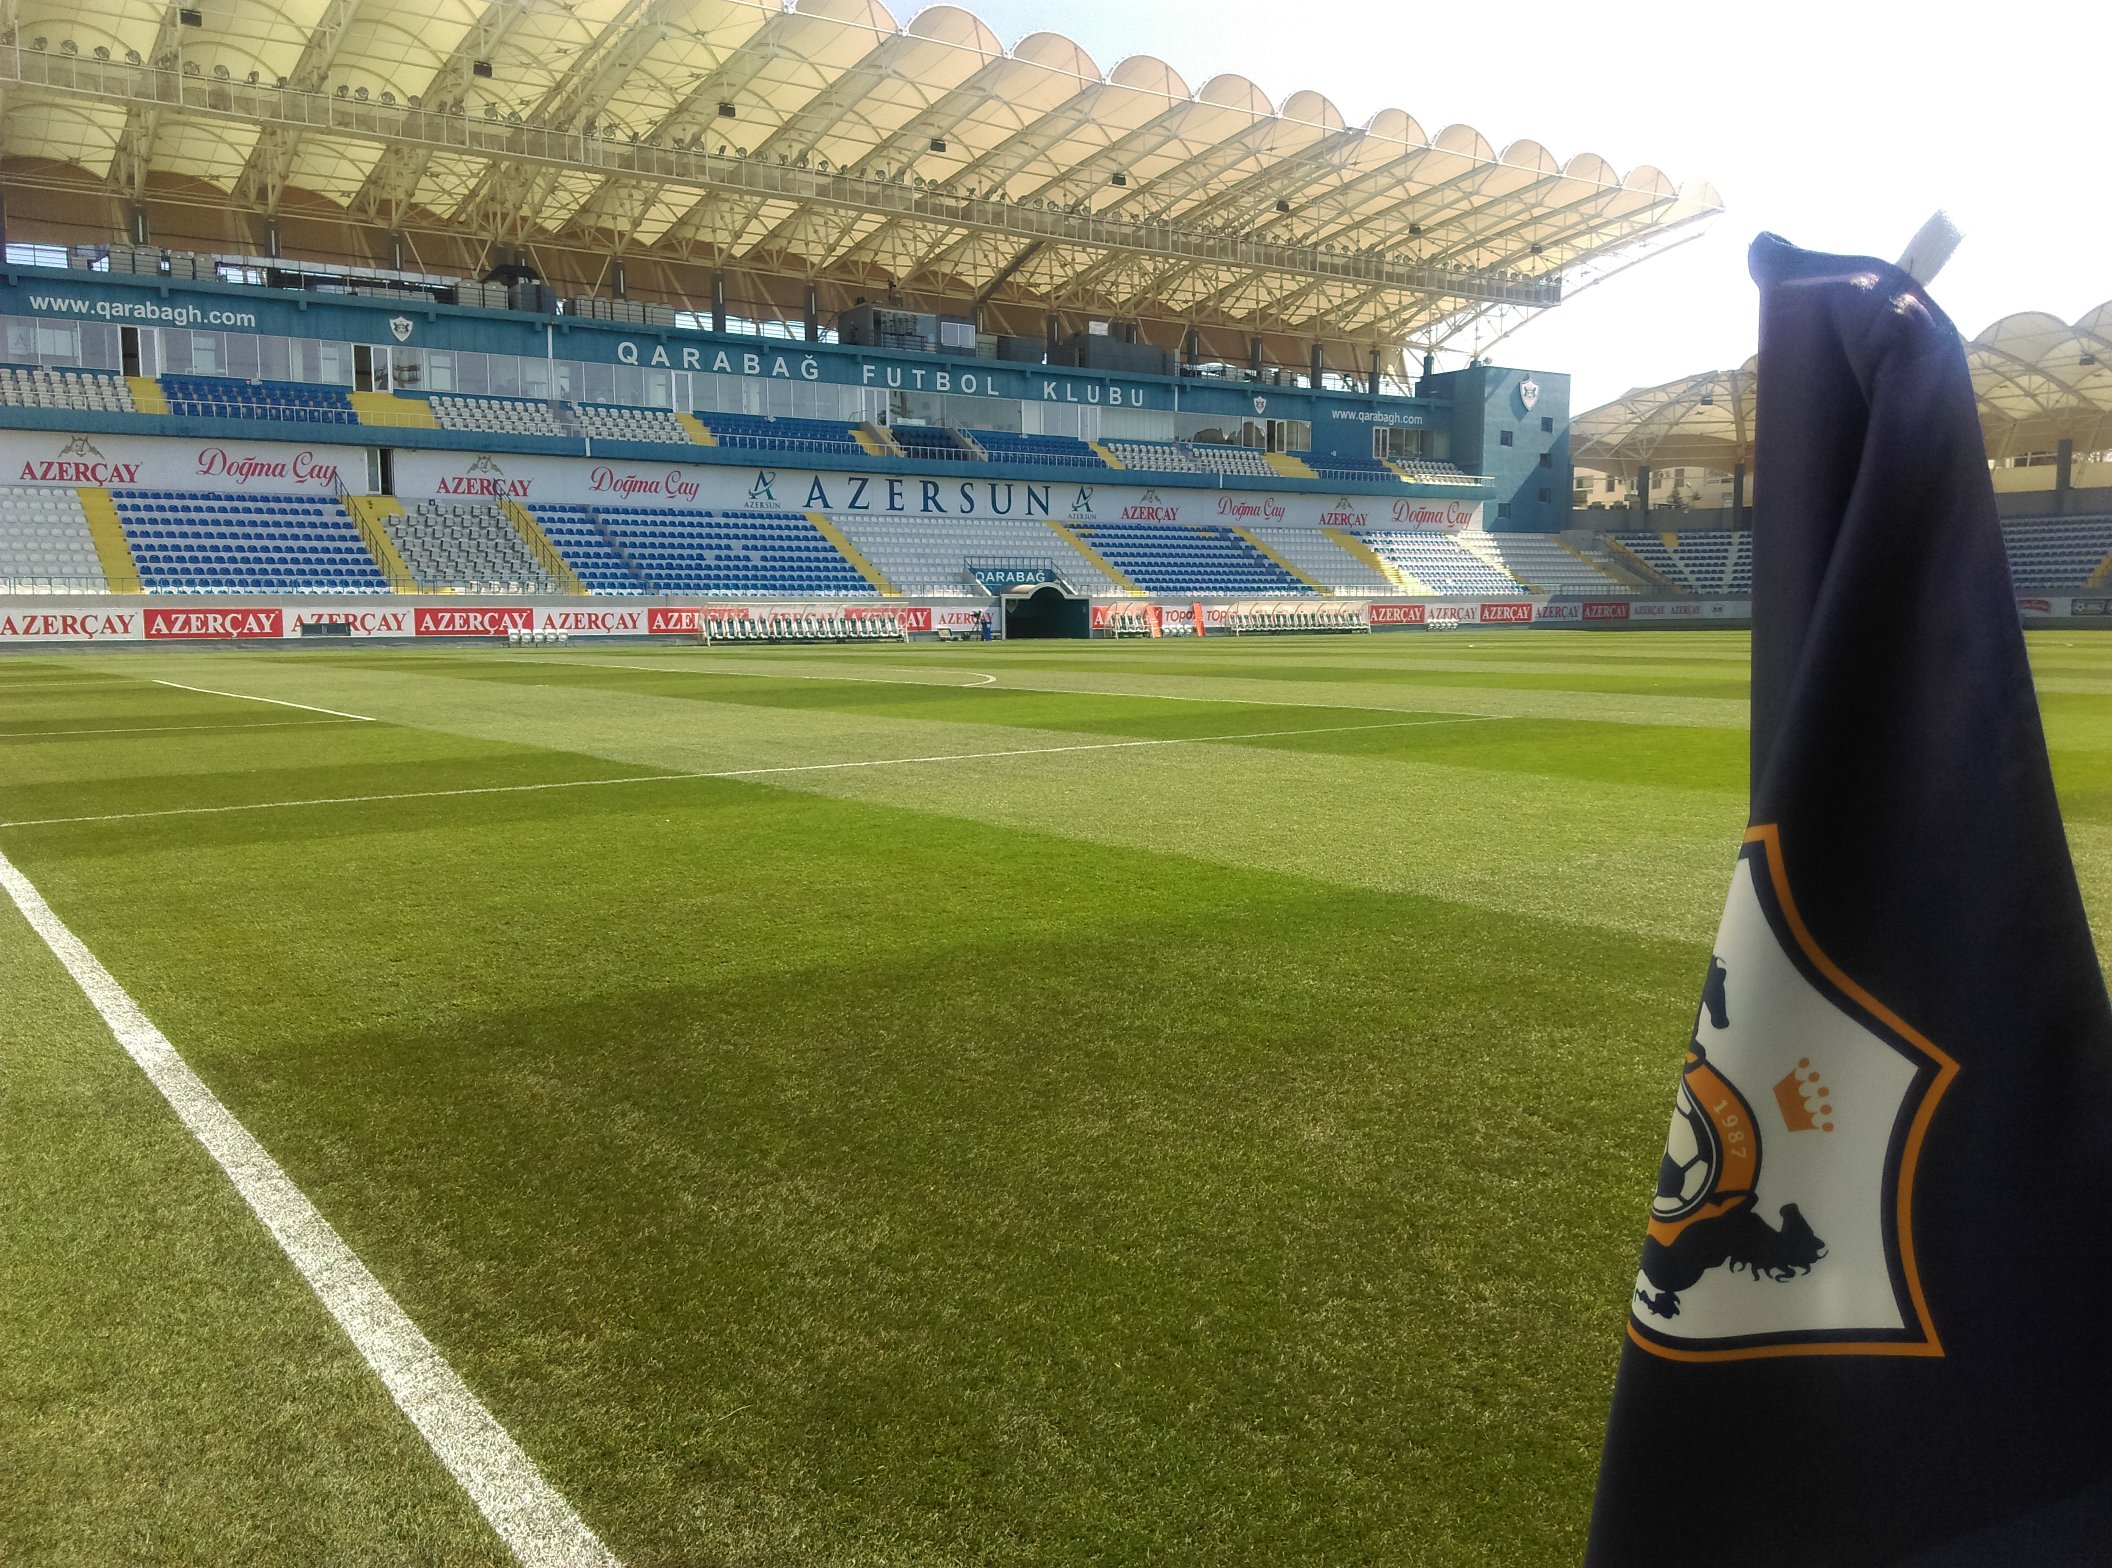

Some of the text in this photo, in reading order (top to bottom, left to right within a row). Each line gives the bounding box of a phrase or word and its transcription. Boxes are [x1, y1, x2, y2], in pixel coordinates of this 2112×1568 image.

[29, 295, 255, 327] www.qarabagh.com
[617, 341, 1143, 407] QARABAĞ FUTBOL KLUBU
[1332, 410, 1422, 425] www.qarabagh.com
[20, 460, 140, 486] AZERÇAY
[196, 447, 338, 487] Doğma Çay
[436, 477, 532, 497] AZERÇAY
[590, 466, 700, 502] Doğma Çay
[744, 501, 781, 509] AZERSUN
[803, 475, 1051, 516] AZERSUN
[1121, 505, 1179, 523] AZERÇAY
[1263, 497, 1286, 521] Çay
[1319, 512, 1368, 528] AZERÇAY
[1447, 501, 1473, 530] Çay
[543, 612, 641, 633] AZERÇAY
[1371, 607, 1423, 622] AZERÇAY
[1428, 607, 1477, 621] AZERÇAY
[1482, 606, 1533, 621] AZERÇAY
[1535, 604, 1579, 619] AZERÇAY
[1583, 604, 1628, 619] AZERÇAY
[0, 614, 135, 639] AZERÇAY
[150, 613, 277, 638] AZERÇAY
[420, 612, 526, 634] AZERÇAY
[1713, 1099, 1747, 1158] 1987
